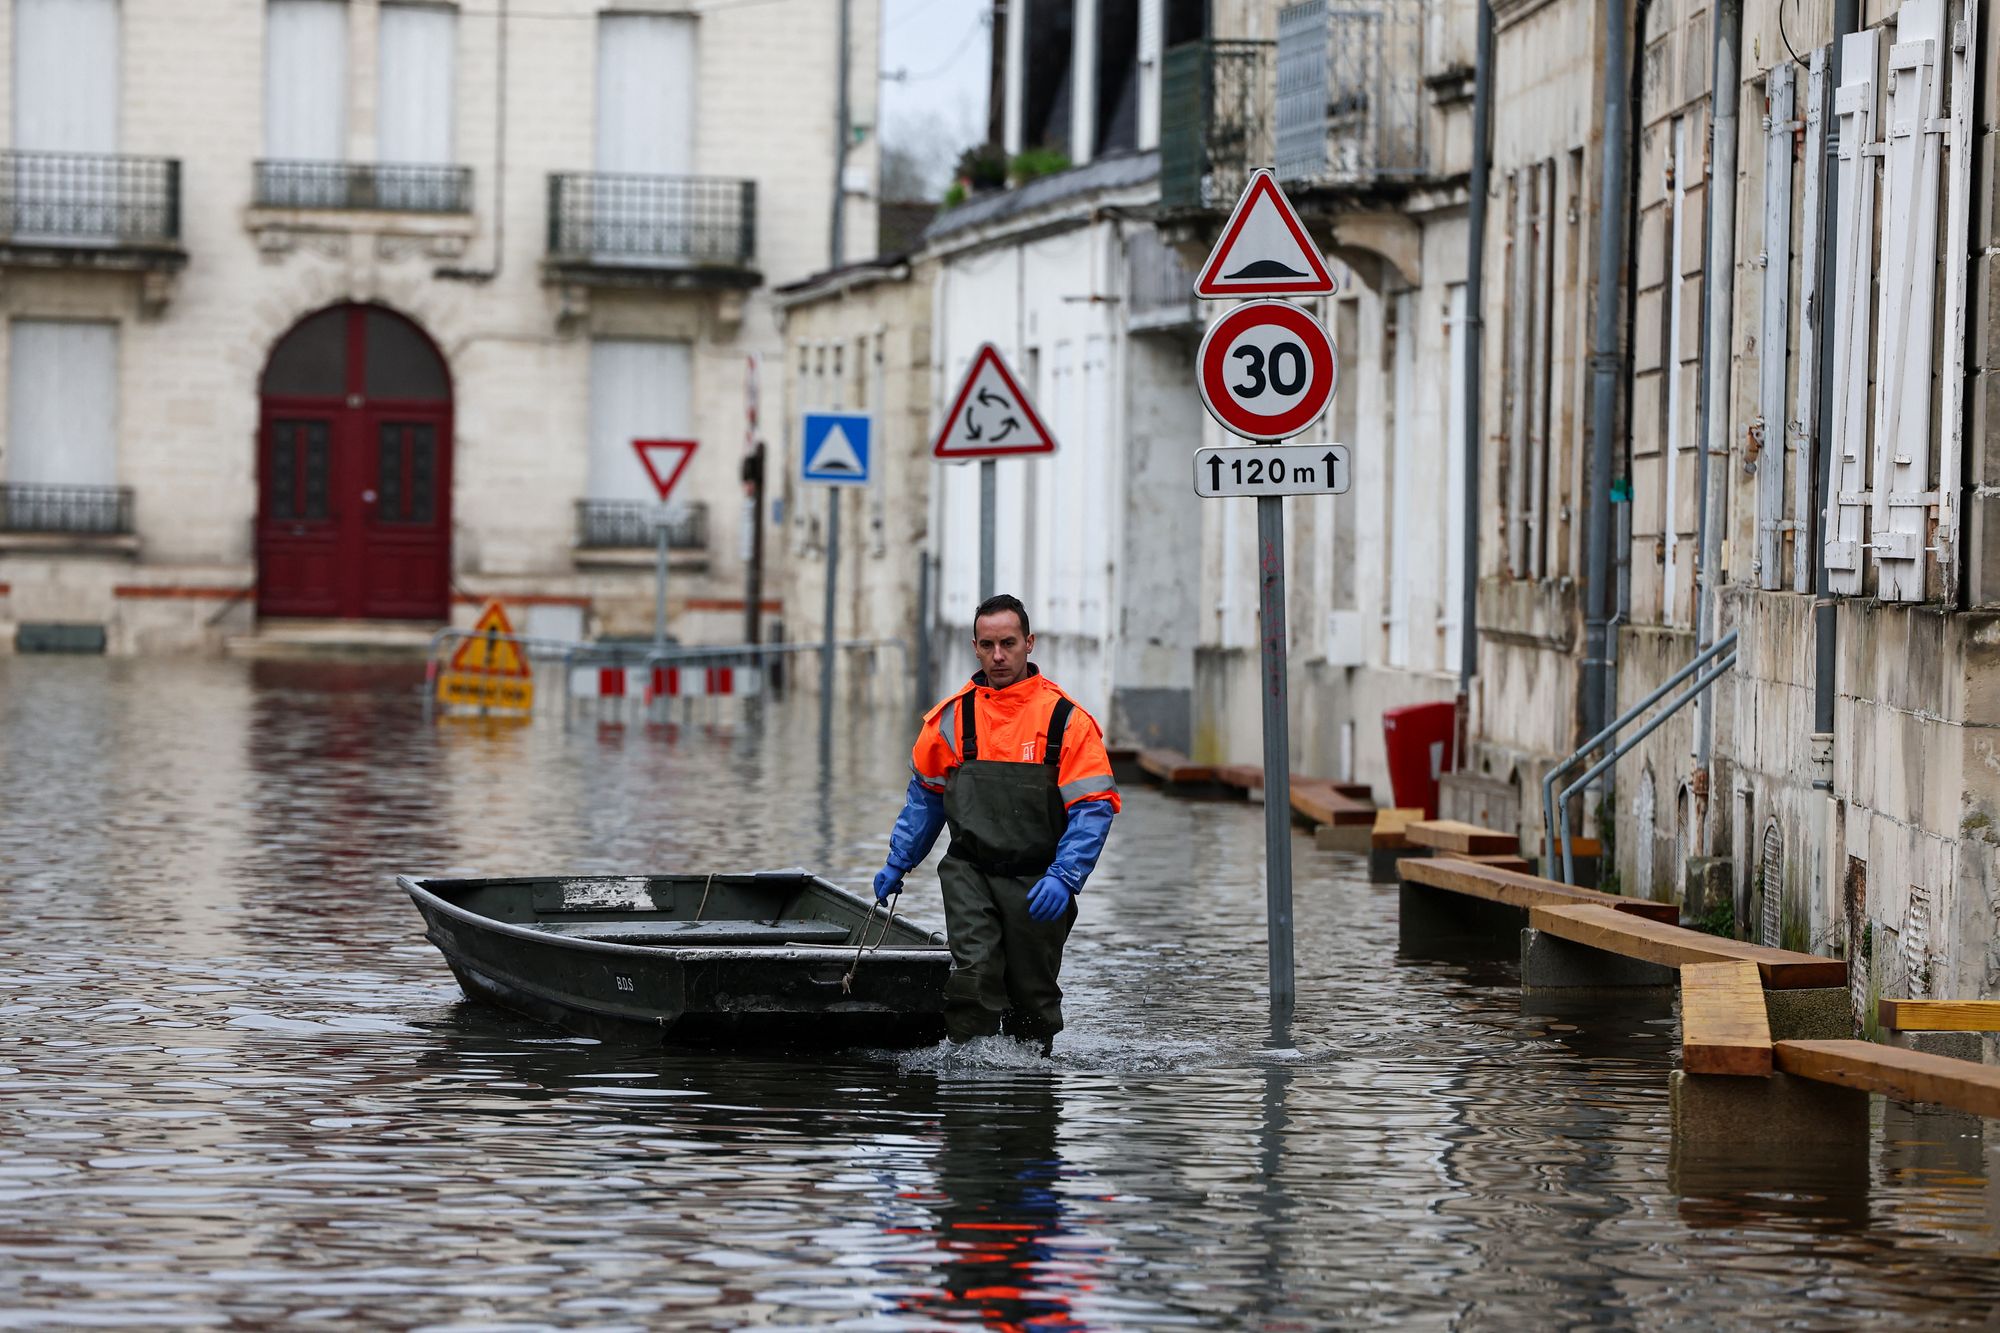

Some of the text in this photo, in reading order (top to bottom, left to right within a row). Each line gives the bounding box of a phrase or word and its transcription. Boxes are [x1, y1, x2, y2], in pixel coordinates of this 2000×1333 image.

[1232, 342, 1307, 399] 30
[1231, 458, 1316, 485] 120 m
